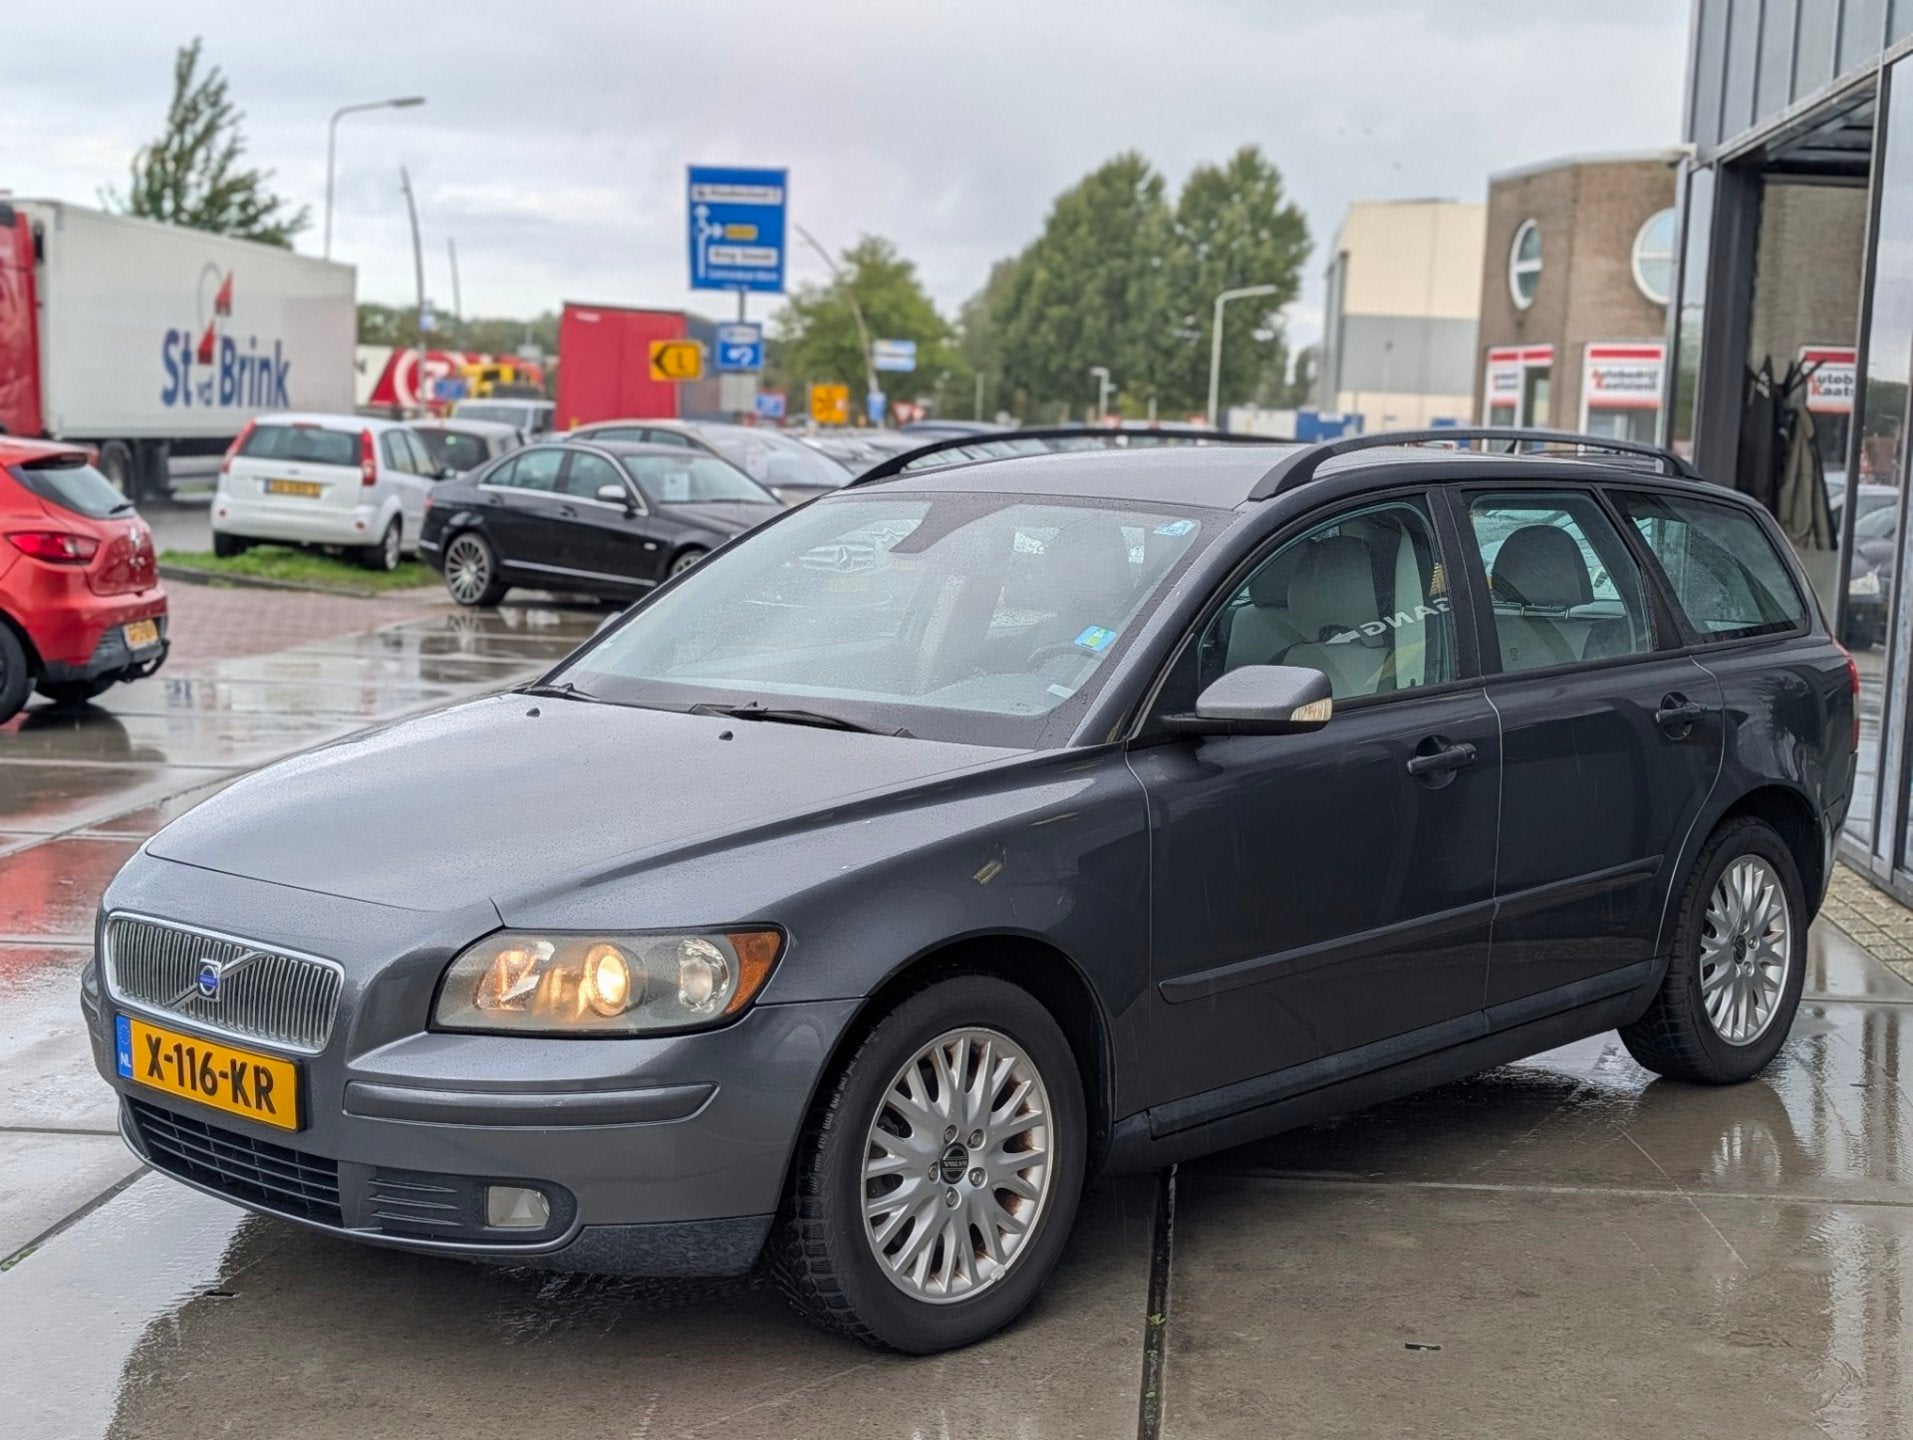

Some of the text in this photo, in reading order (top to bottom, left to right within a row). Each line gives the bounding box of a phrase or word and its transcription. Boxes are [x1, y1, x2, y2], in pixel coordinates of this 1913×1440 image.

[162, 328, 192, 407] St
[220, 335, 290, 408] Brink
[120, 1052, 131, 1068] NL
[145, 1033, 276, 1115] X-116-KR
